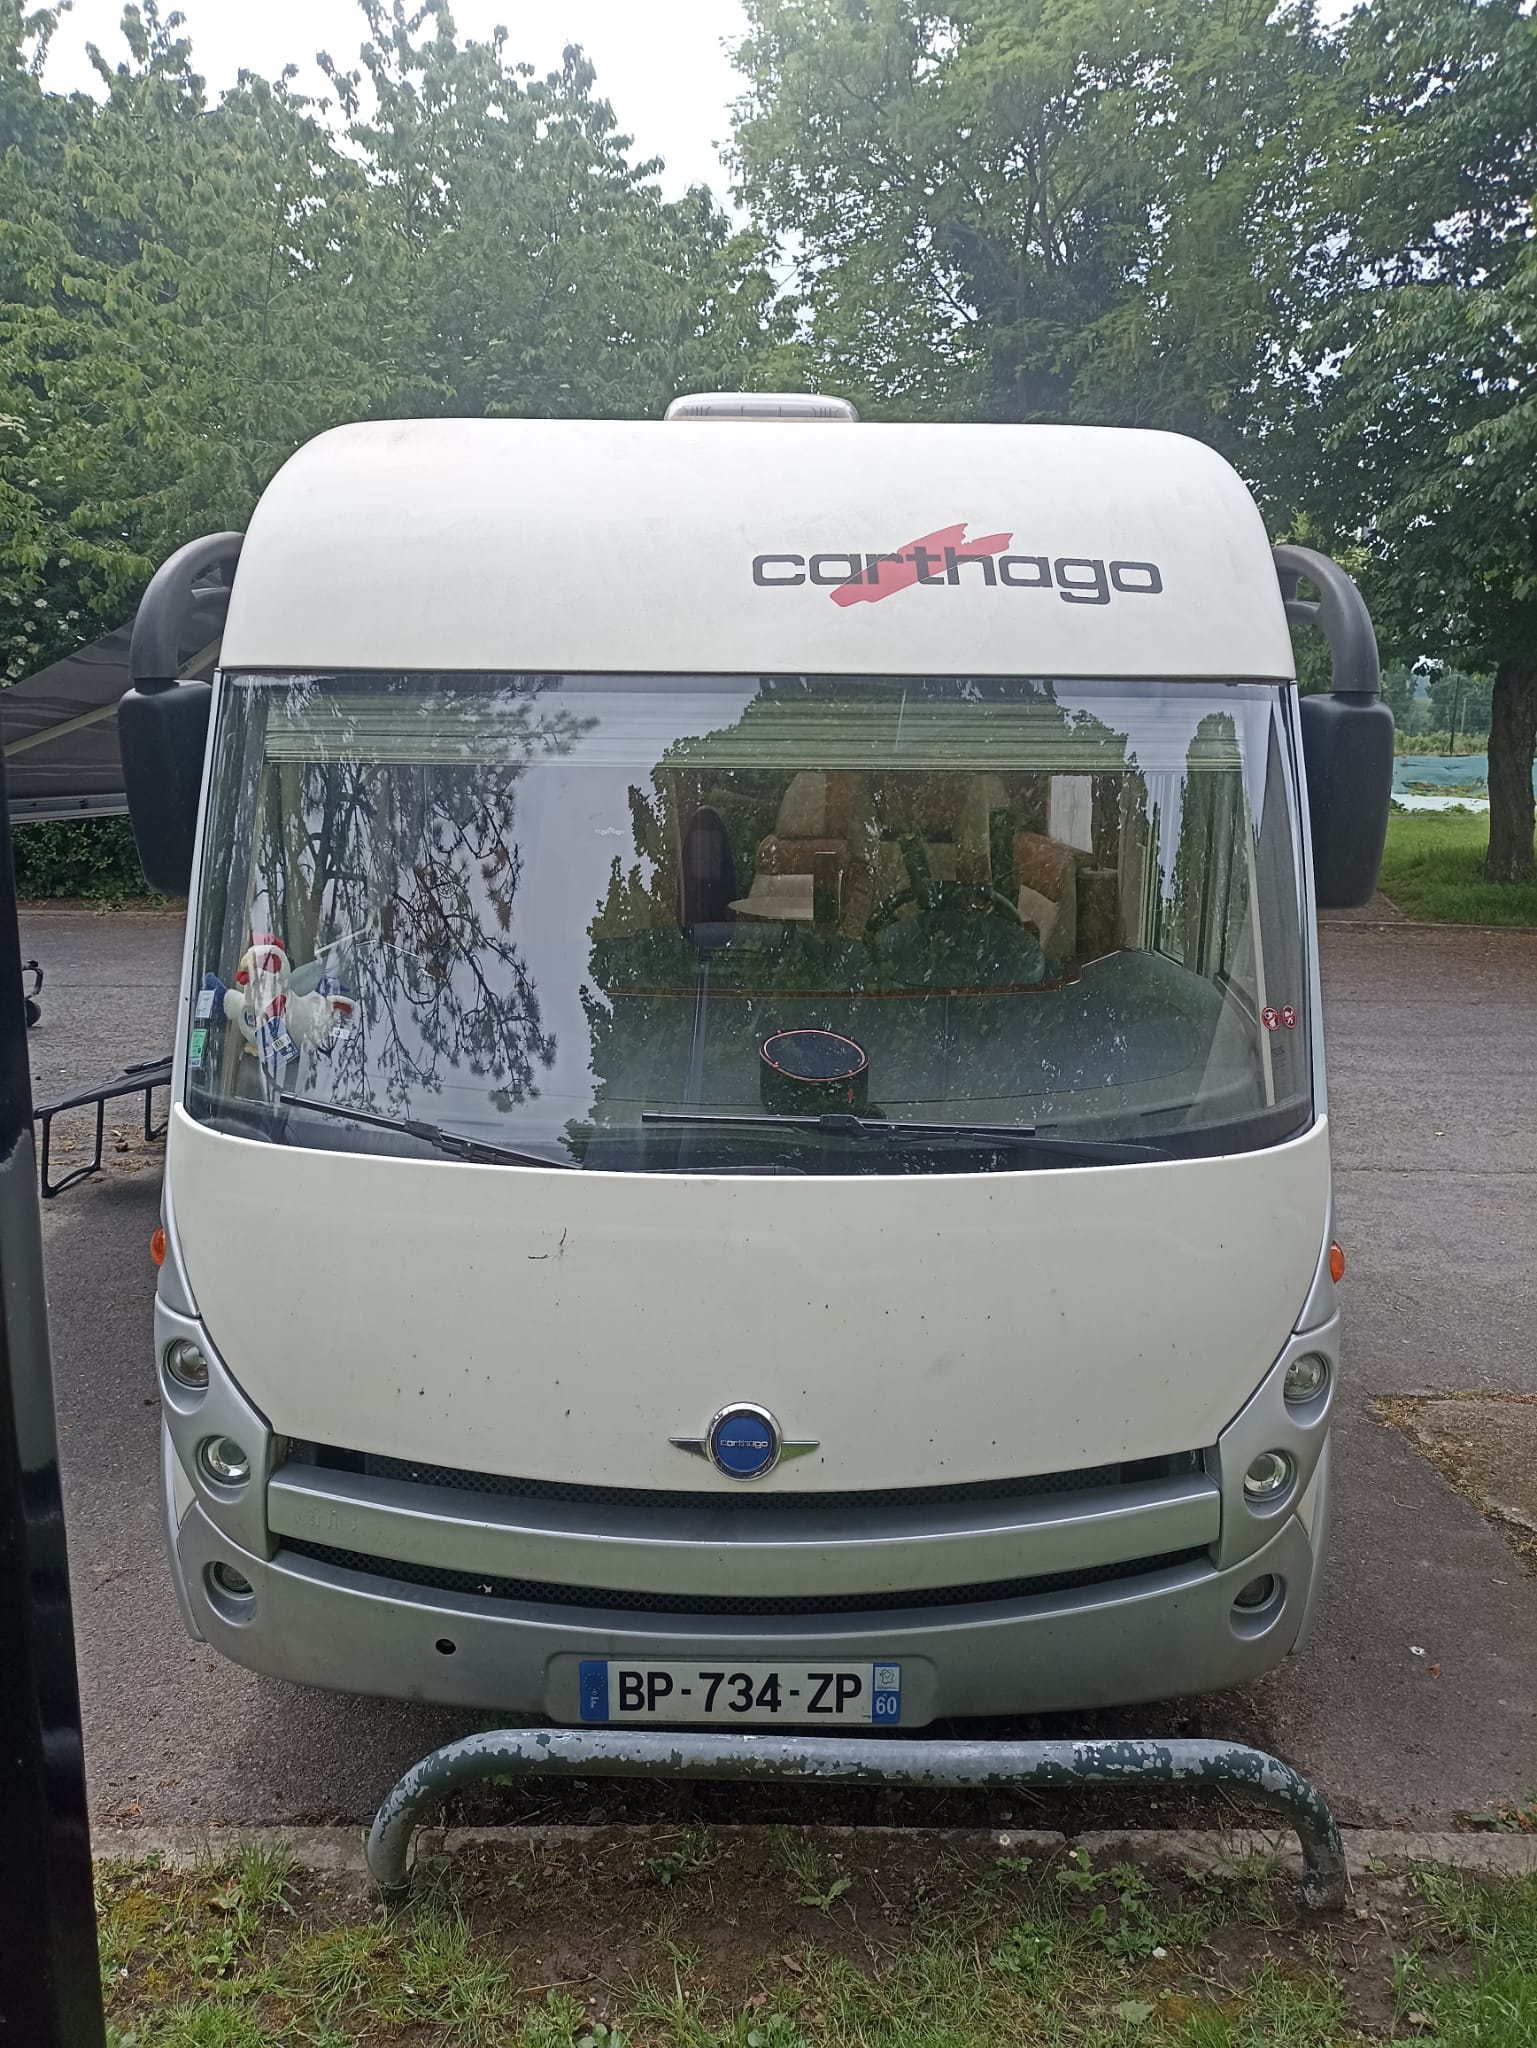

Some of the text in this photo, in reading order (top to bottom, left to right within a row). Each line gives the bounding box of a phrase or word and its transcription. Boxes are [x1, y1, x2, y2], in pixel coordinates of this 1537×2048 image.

[752, 546, 1163, 605] carthago
[618, 1671, 863, 1714] BP-734-ZP
[876, 1696, 897, 1715] 60
